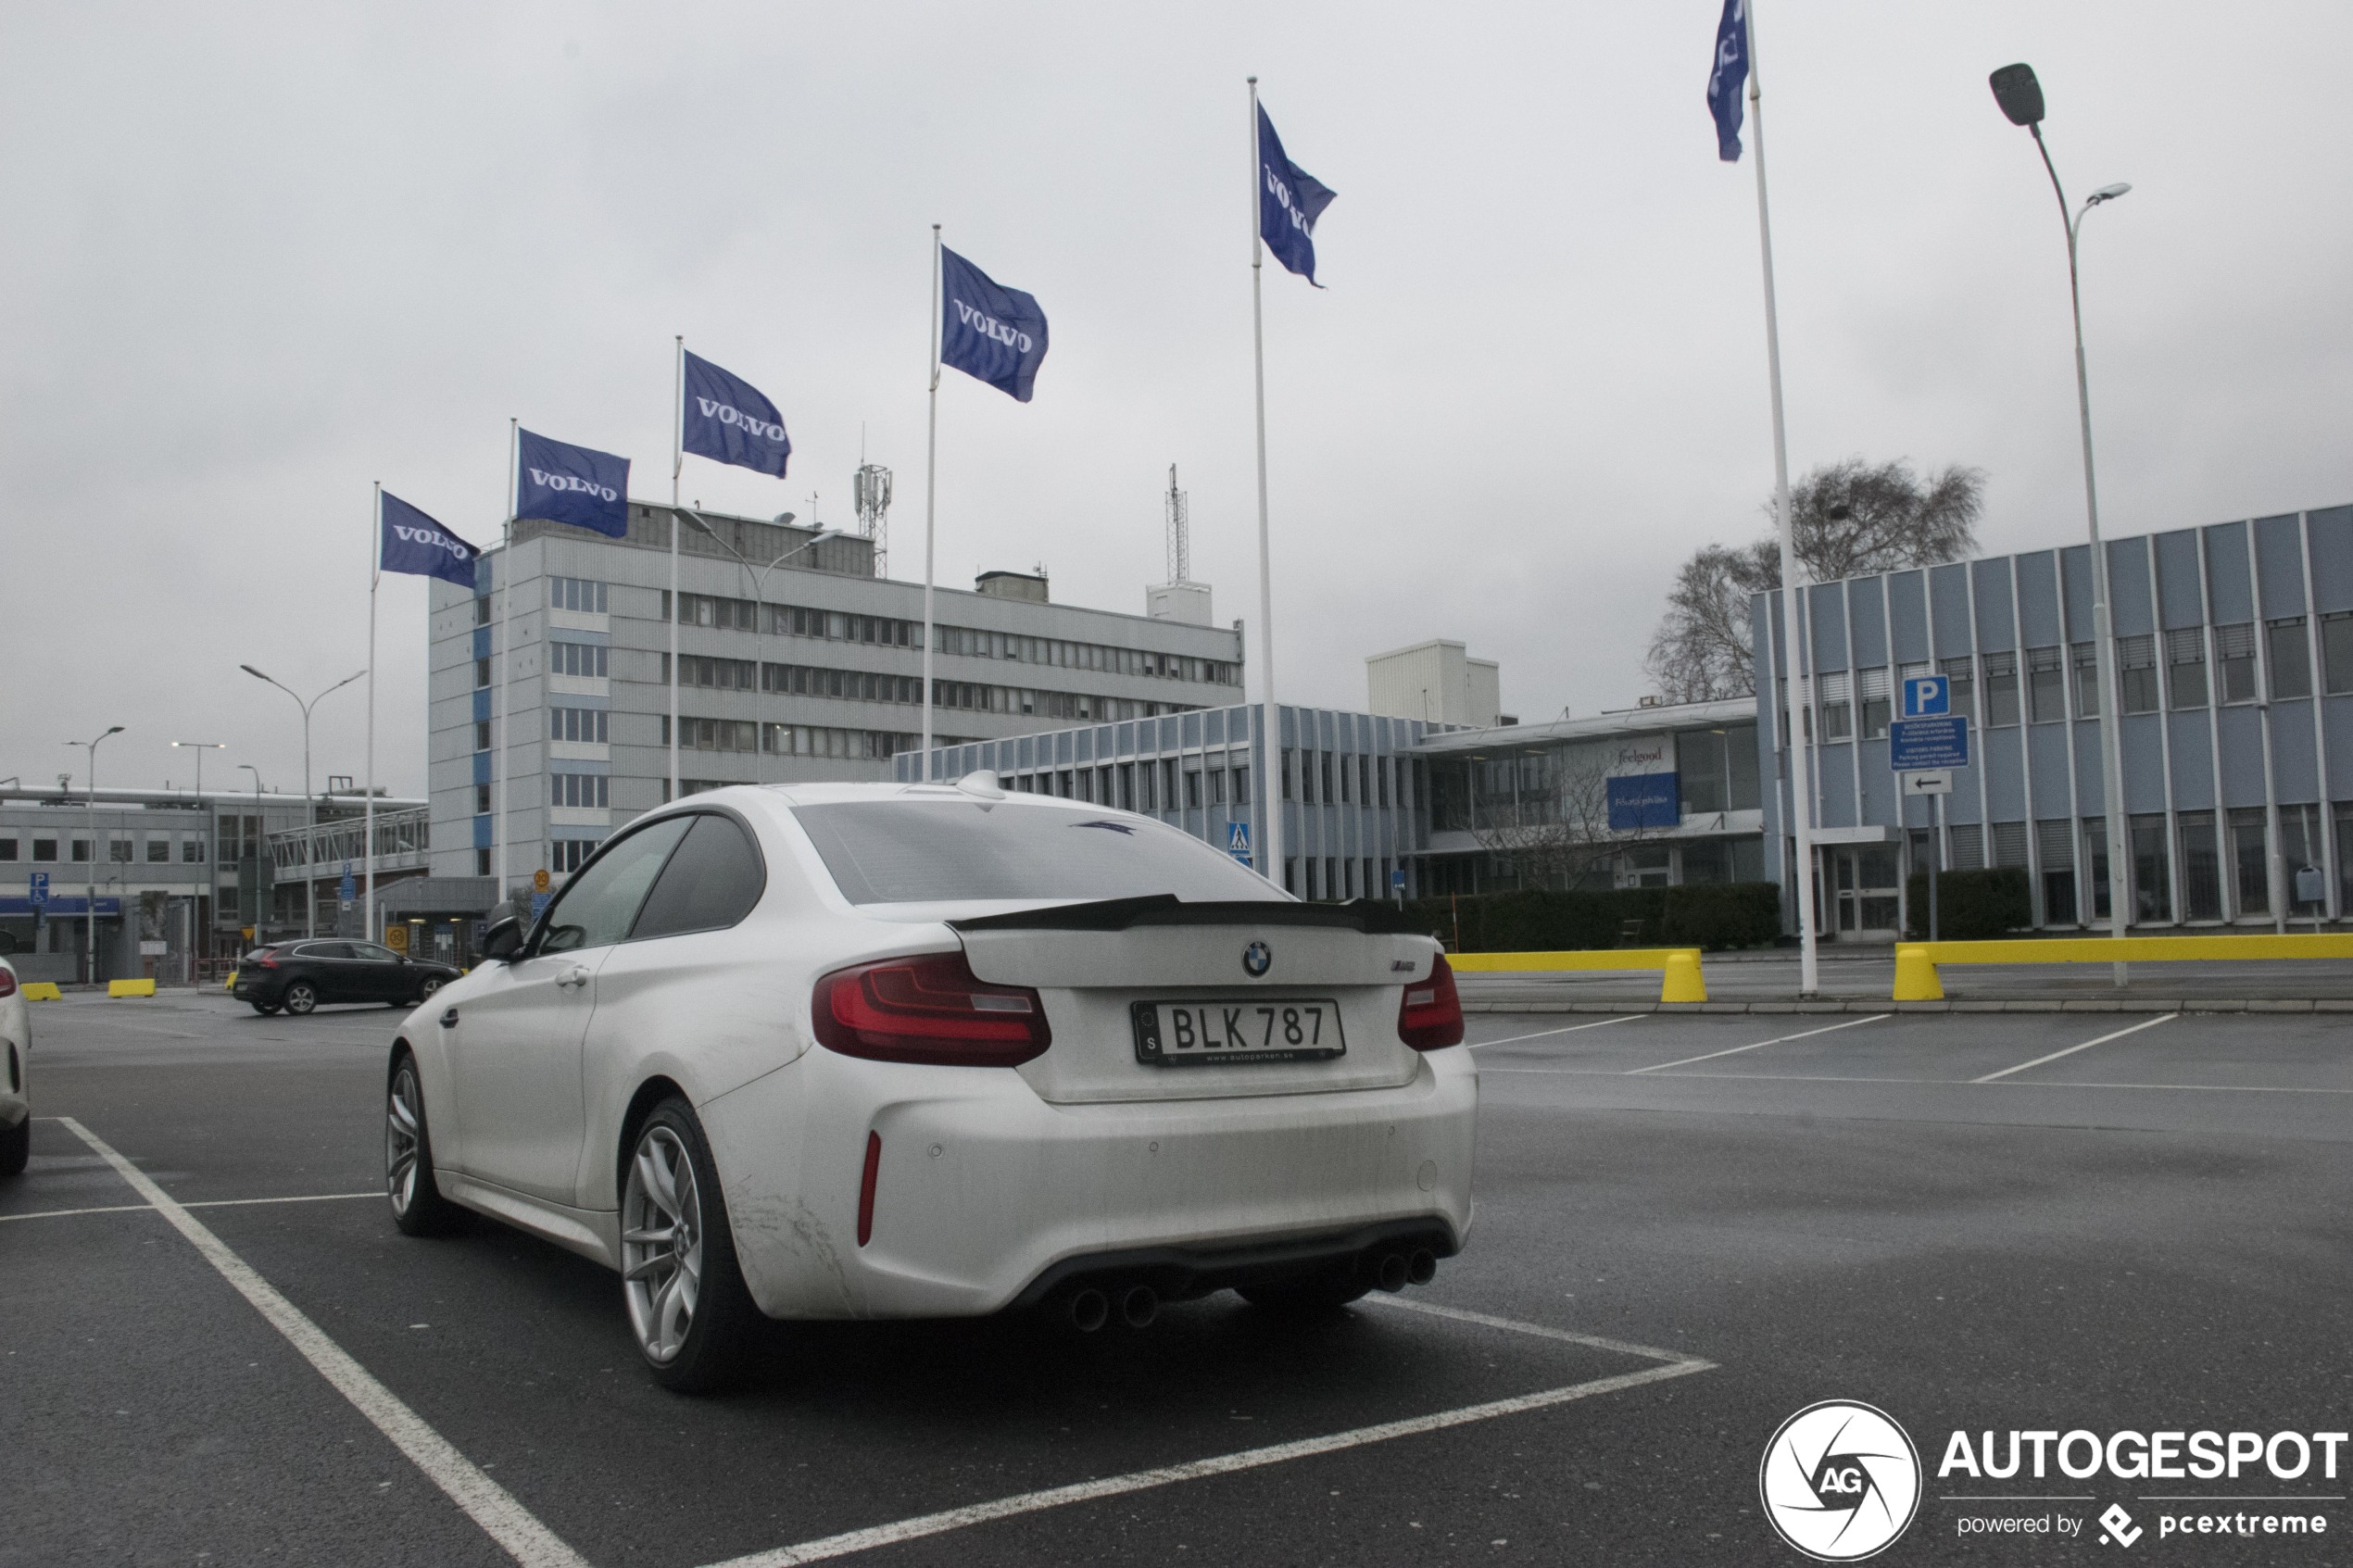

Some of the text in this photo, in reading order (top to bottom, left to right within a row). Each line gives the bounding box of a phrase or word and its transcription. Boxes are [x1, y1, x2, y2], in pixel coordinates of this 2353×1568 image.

[953, 299, 1032, 353] VOLVO
[697, 396, 786, 442] VOLVO
[529, 467, 617, 502] VOLVO
[393, 525, 468, 559] VOLVO
[1917, 681, 1939, 712] P
[1617, 746, 1662, 766] feelgood
[1937, 751, 1960, 759] required
[1941, 758, 1966, 766] reception
[36, 873, 44, 886] P
[536, 873, 547, 883] 30
[1172, 1007, 1322, 1048] BLK 787
[1147, 1037, 1156, 1049] S
[1206, 1052, 1294, 1062] www.autoparken.se
